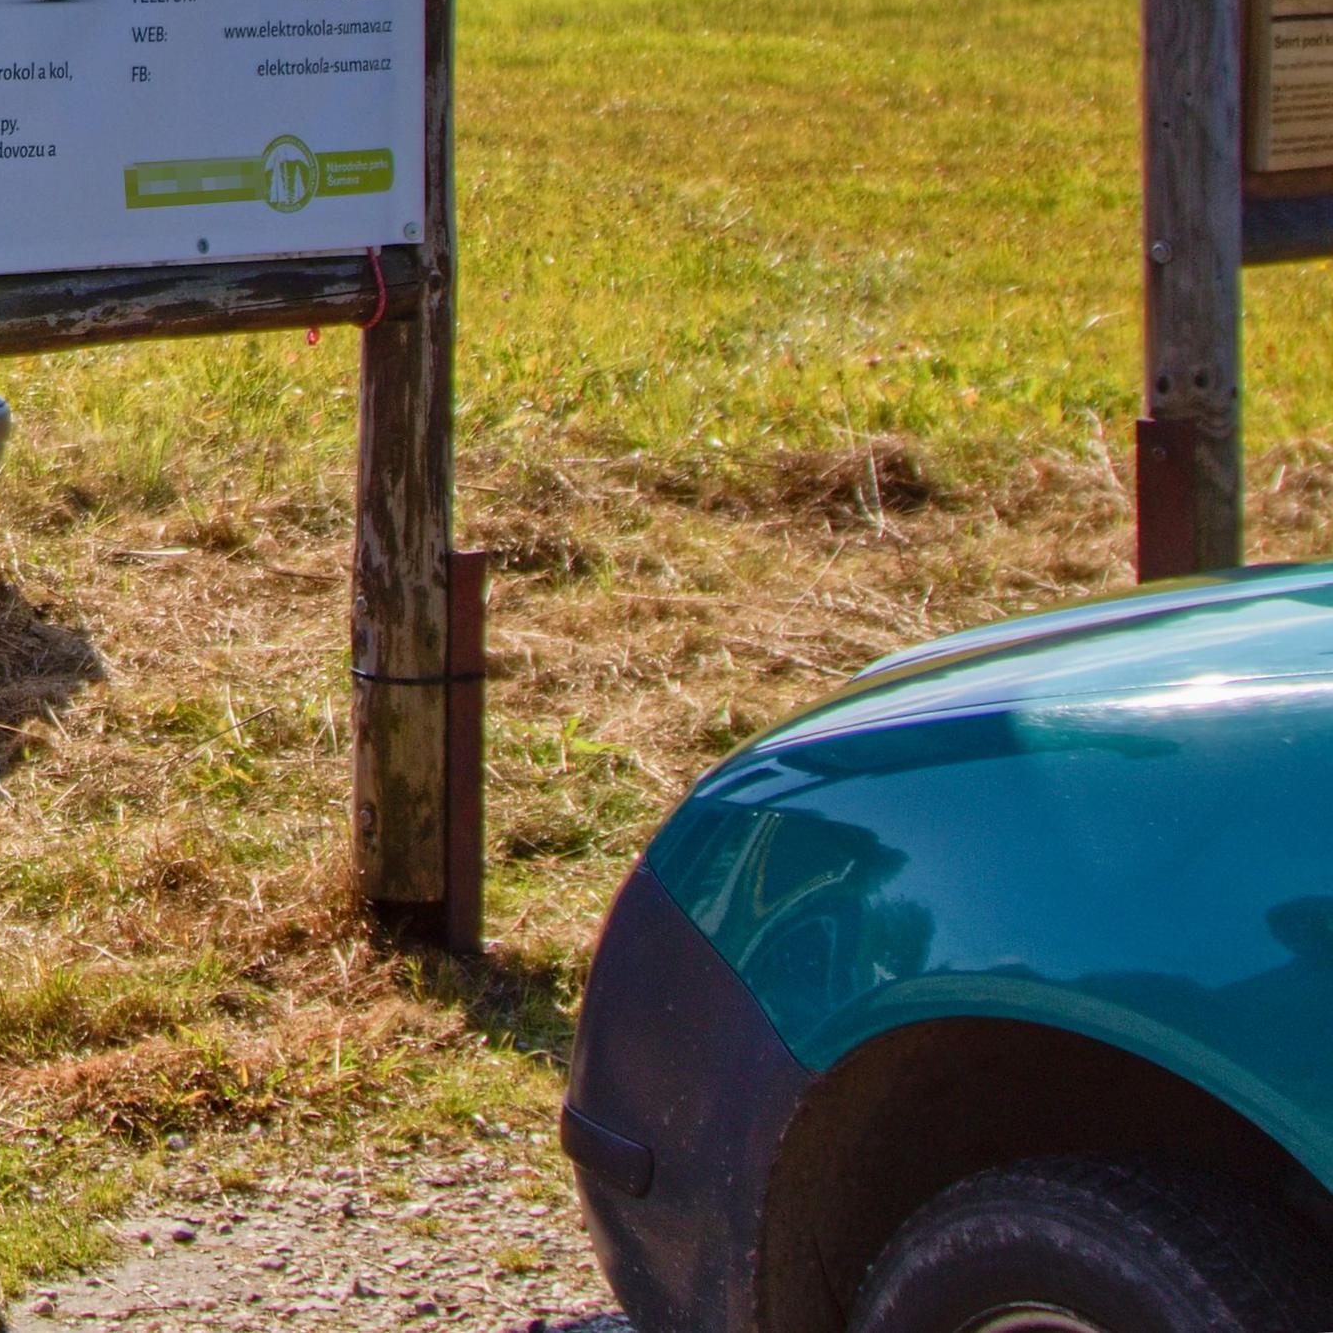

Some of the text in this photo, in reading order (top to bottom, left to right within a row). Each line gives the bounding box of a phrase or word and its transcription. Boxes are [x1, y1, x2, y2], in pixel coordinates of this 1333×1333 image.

[132, 19, 393, 43] WEB: www.elektrokola-sumava.cz
[37, 67, 46, 80] a
[48, 61, 73, 82] kol,
[131, 57, 392, 82] FB: elektrokola-sumava.cz
[48, 144, 57, 157] a
